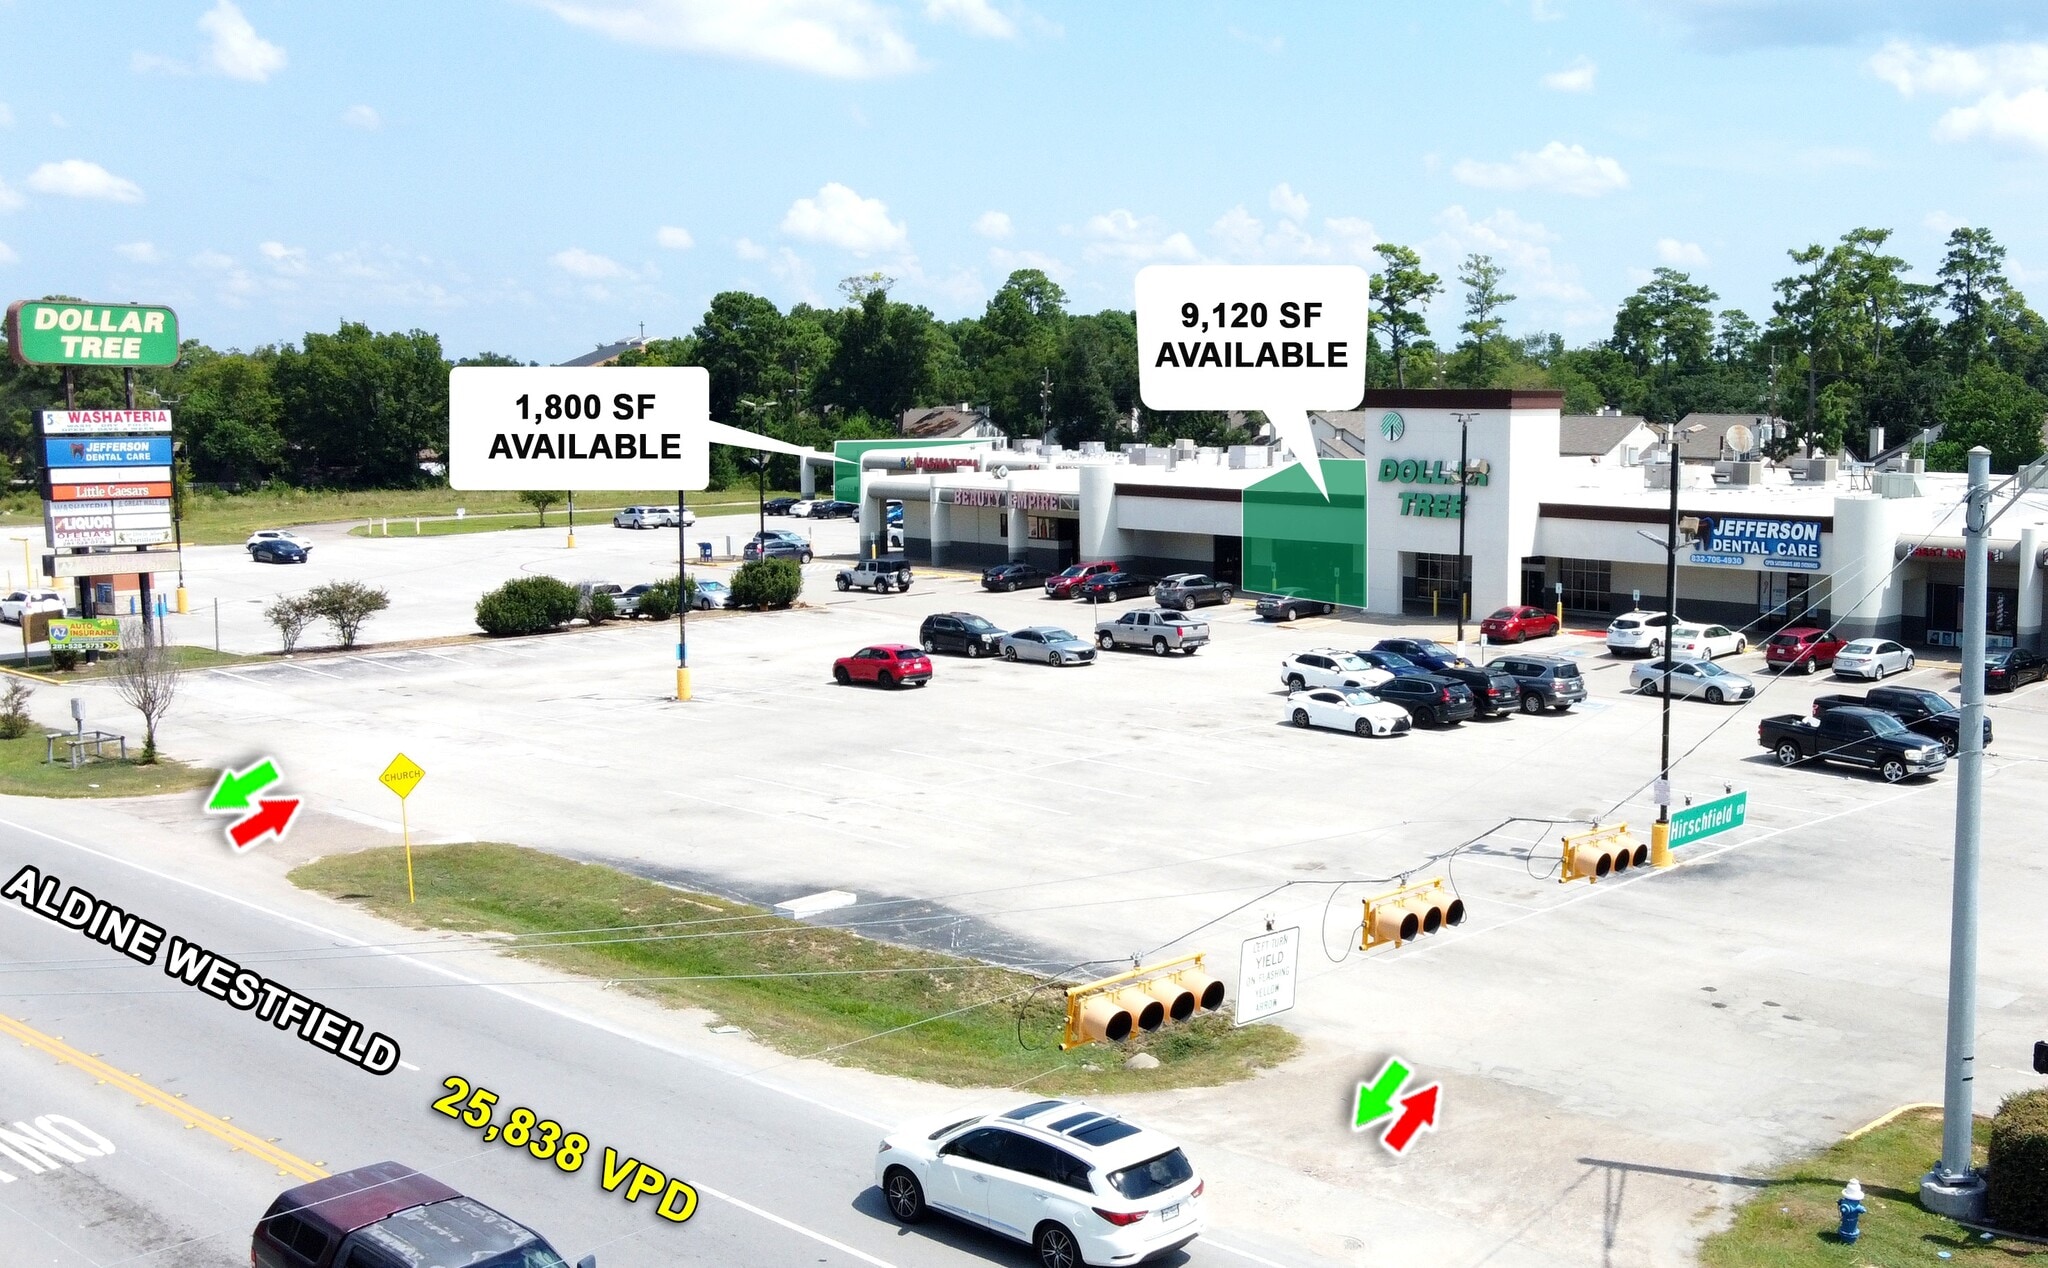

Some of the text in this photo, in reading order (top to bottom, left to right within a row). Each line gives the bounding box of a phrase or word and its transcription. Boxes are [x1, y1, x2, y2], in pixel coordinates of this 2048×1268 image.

[34, 307, 165, 333] DOLLAR
[60, 336, 142, 359] TREE
[46, 411, 167, 425] 5 WASHATERIA
[86, 442, 150, 452] JEFFERSON
[86, 453, 122, 461] DENTAL
[1378, 458, 1490, 486] DOLL
[75, 485, 149, 497] Little Caesars
[954, 488, 1059, 510] BEAUTY EMPIRE
[1398, 492, 1468, 518] TREE
[65, 516, 112, 530] LIQUOR
[1713, 520, 1818, 540] JEFFERSON
[1713, 539, 1818, 557] DENTAL CARE
[53, 628, 67, 637] AZ
[384, 770, 421, 782] CHURCH
[1670, 804, 1733, 840] Hirschfield
[1253, 934, 1288, 953] LEFT TURN
[1256, 951, 1284, 969] YIELD
[1246, 966, 1290, 987] ON FLASHING
[1255, 984, 1279, 997] YELLOW
[1256, 999, 1277, 1011] ARROW
